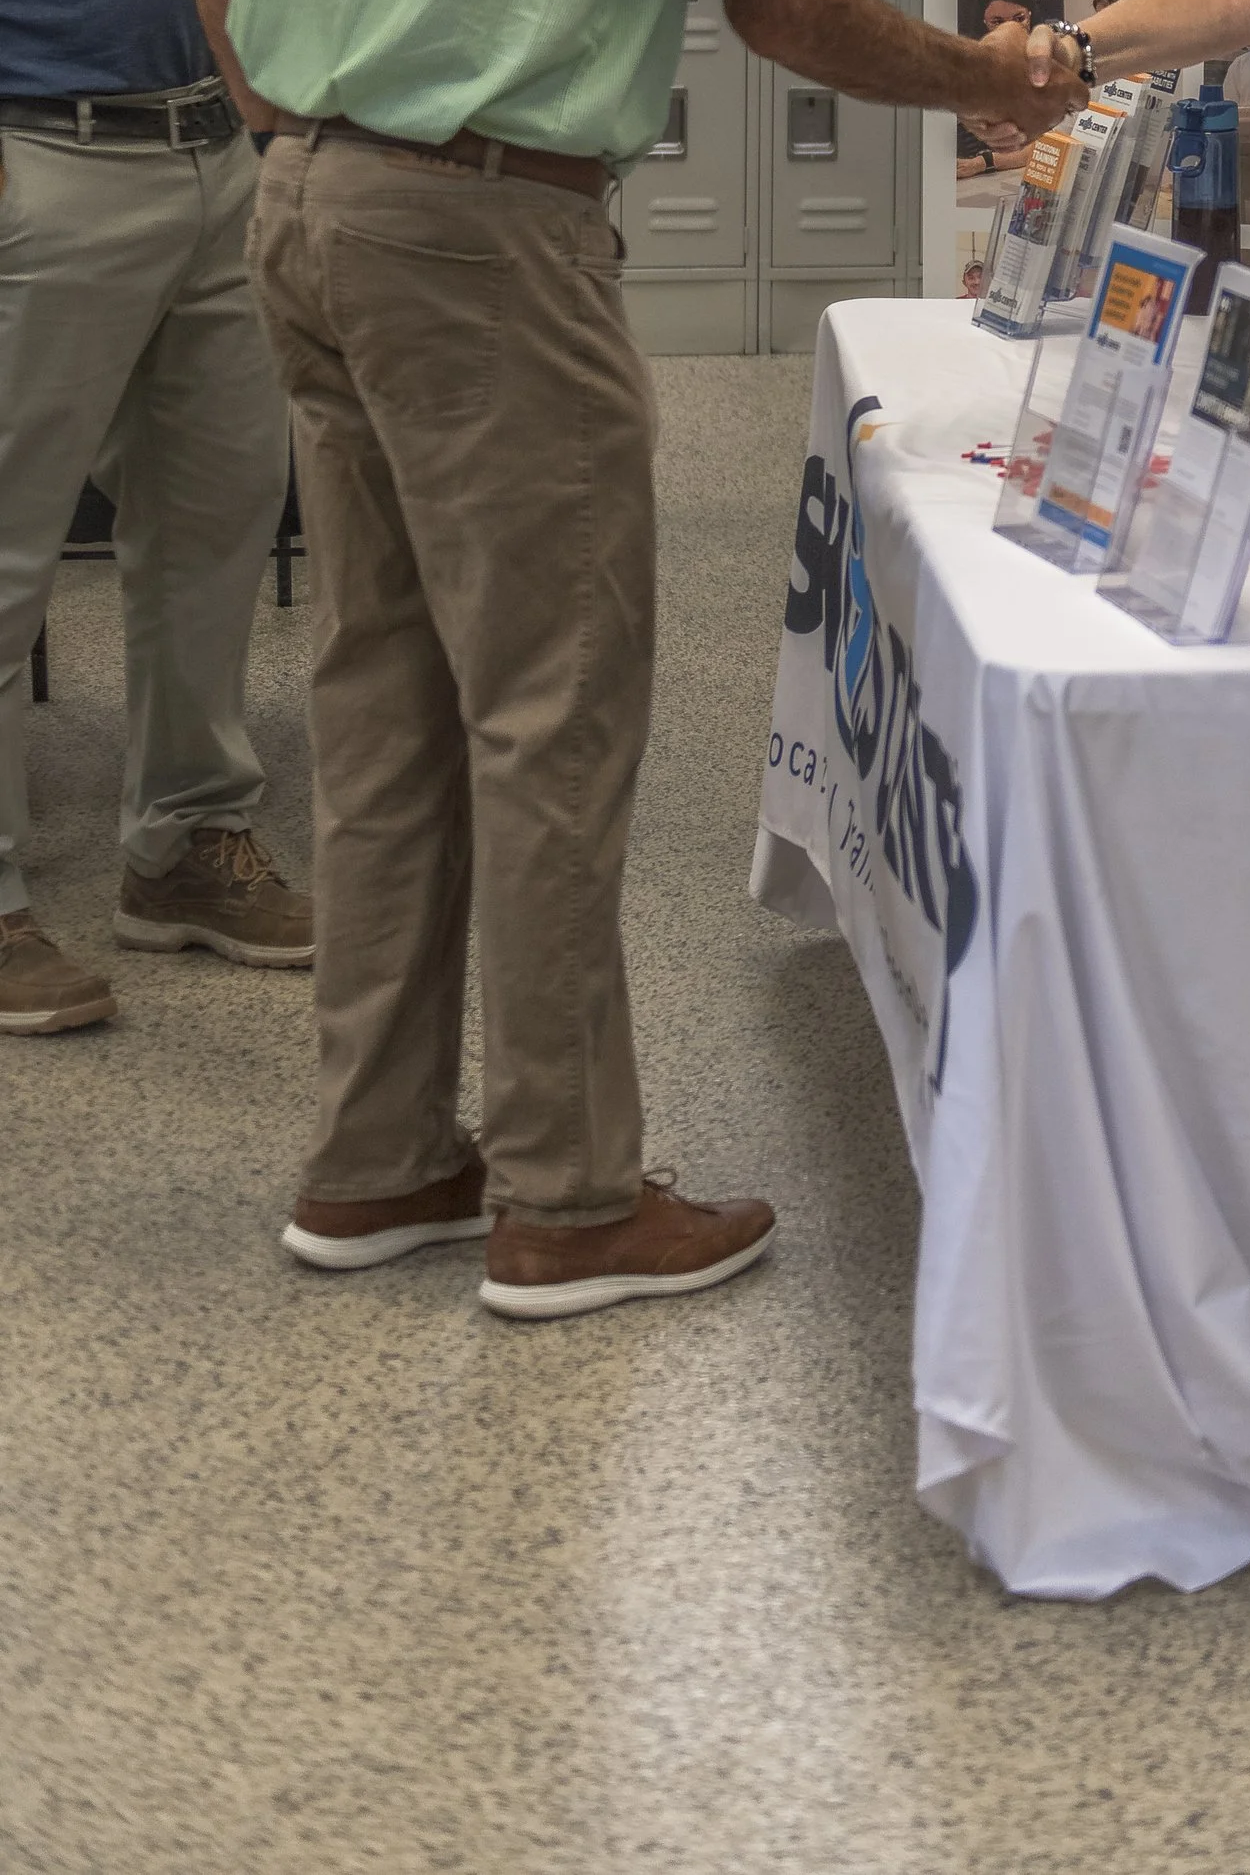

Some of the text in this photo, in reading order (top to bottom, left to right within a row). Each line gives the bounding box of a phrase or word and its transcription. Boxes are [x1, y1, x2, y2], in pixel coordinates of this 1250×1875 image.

[1092, 123, 1108, 134] CENTER
[1035, 140, 1060, 156] VOCATIONAL
[1032, 150, 1058, 167] TRAINING
[1027, 168, 1053, 184] DISABILITIES
